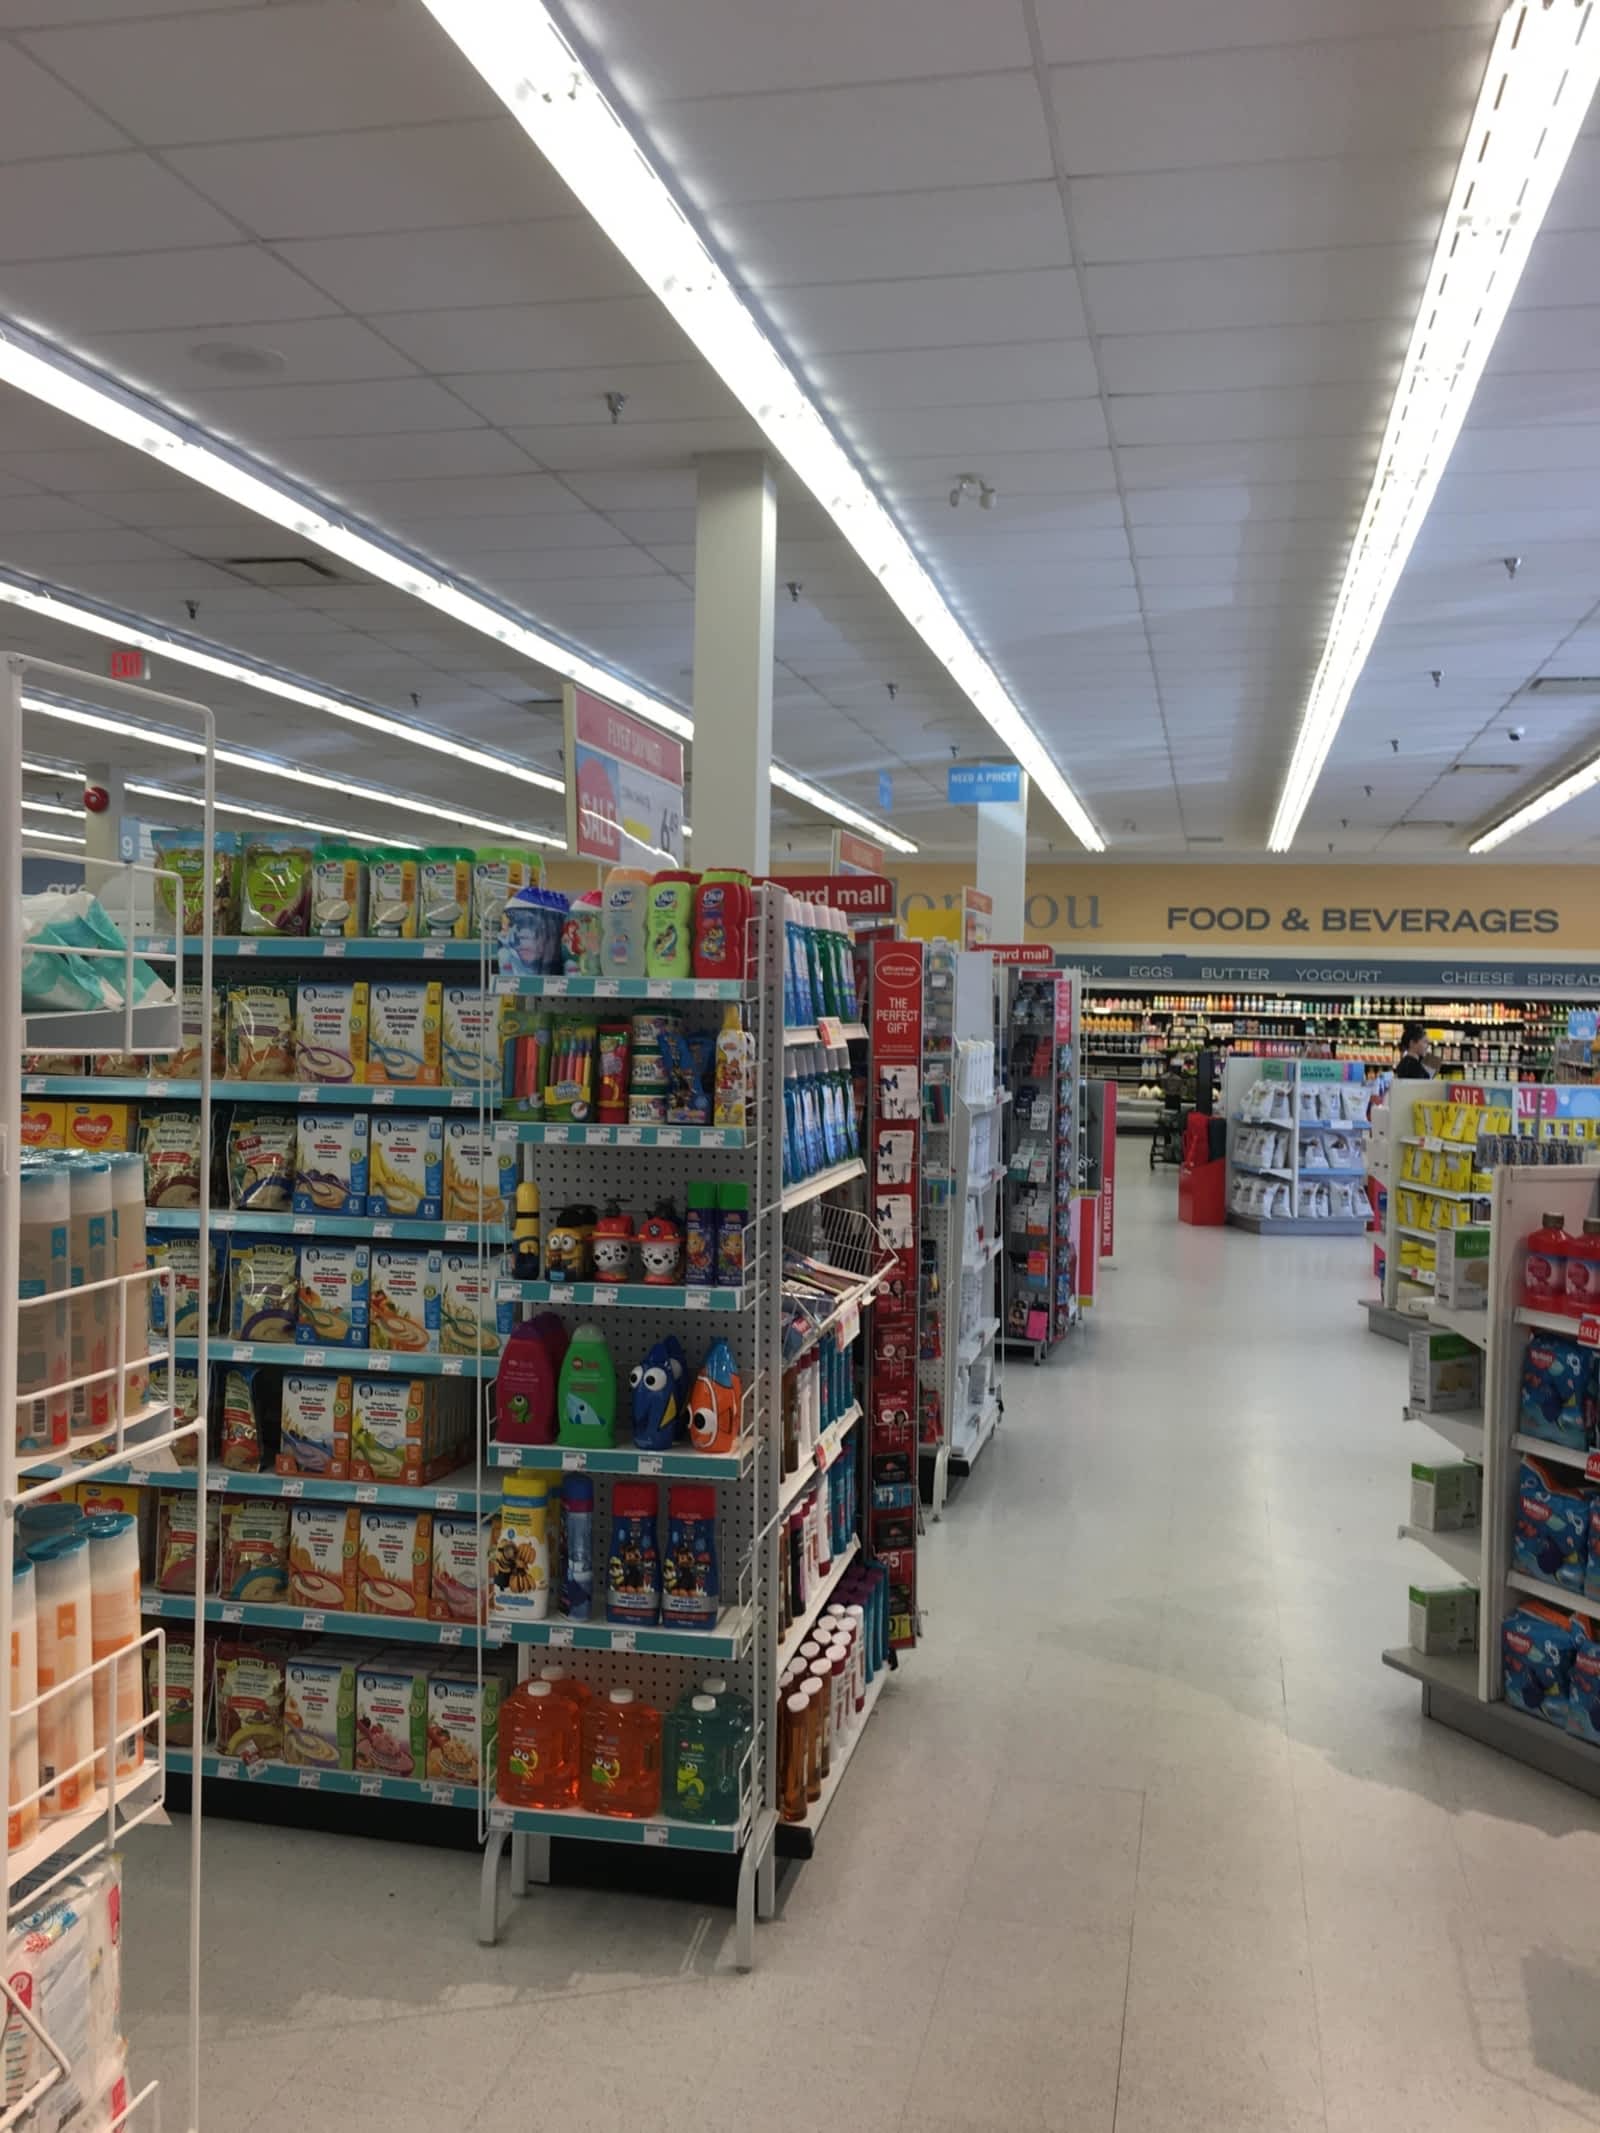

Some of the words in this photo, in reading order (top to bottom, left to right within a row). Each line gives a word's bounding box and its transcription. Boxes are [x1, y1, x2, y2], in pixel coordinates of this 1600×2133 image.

[112, 652, 143, 678] EXIT
[580, 792, 616, 847] SALE
[122, 836, 133, 857] 9
[837, 884, 886, 905] mall
[1025, 893, 1104, 930] ou
[1167, 907, 1271, 931] FOOD
[1281, 908, 1310, 931] &
[1322, 908, 1560, 933] BEVERAGES
[992, 948, 1019, 960] card
[1022, 948, 1049, 960] mall
[1129, 966, 1173, 978] EGGS
[1201, 967, 1270, 980] BUTTER
[1295, 968, 1382, 983] YOGOURT
[1441, 971, 1514, 985] CHEESE
[888, 997, 908, 1010] THE
[876, 1010, 919, 1022] PERFECT
[887, 1022, 909, 1034] GIFT
[1454, 1087, 1479, 1106] SALE
[1518, 1090, 1548, 1113] ALE
[1580, 1326, 1599, 1341] SALE
[1588, 1458, 1600, 1473] SAL
